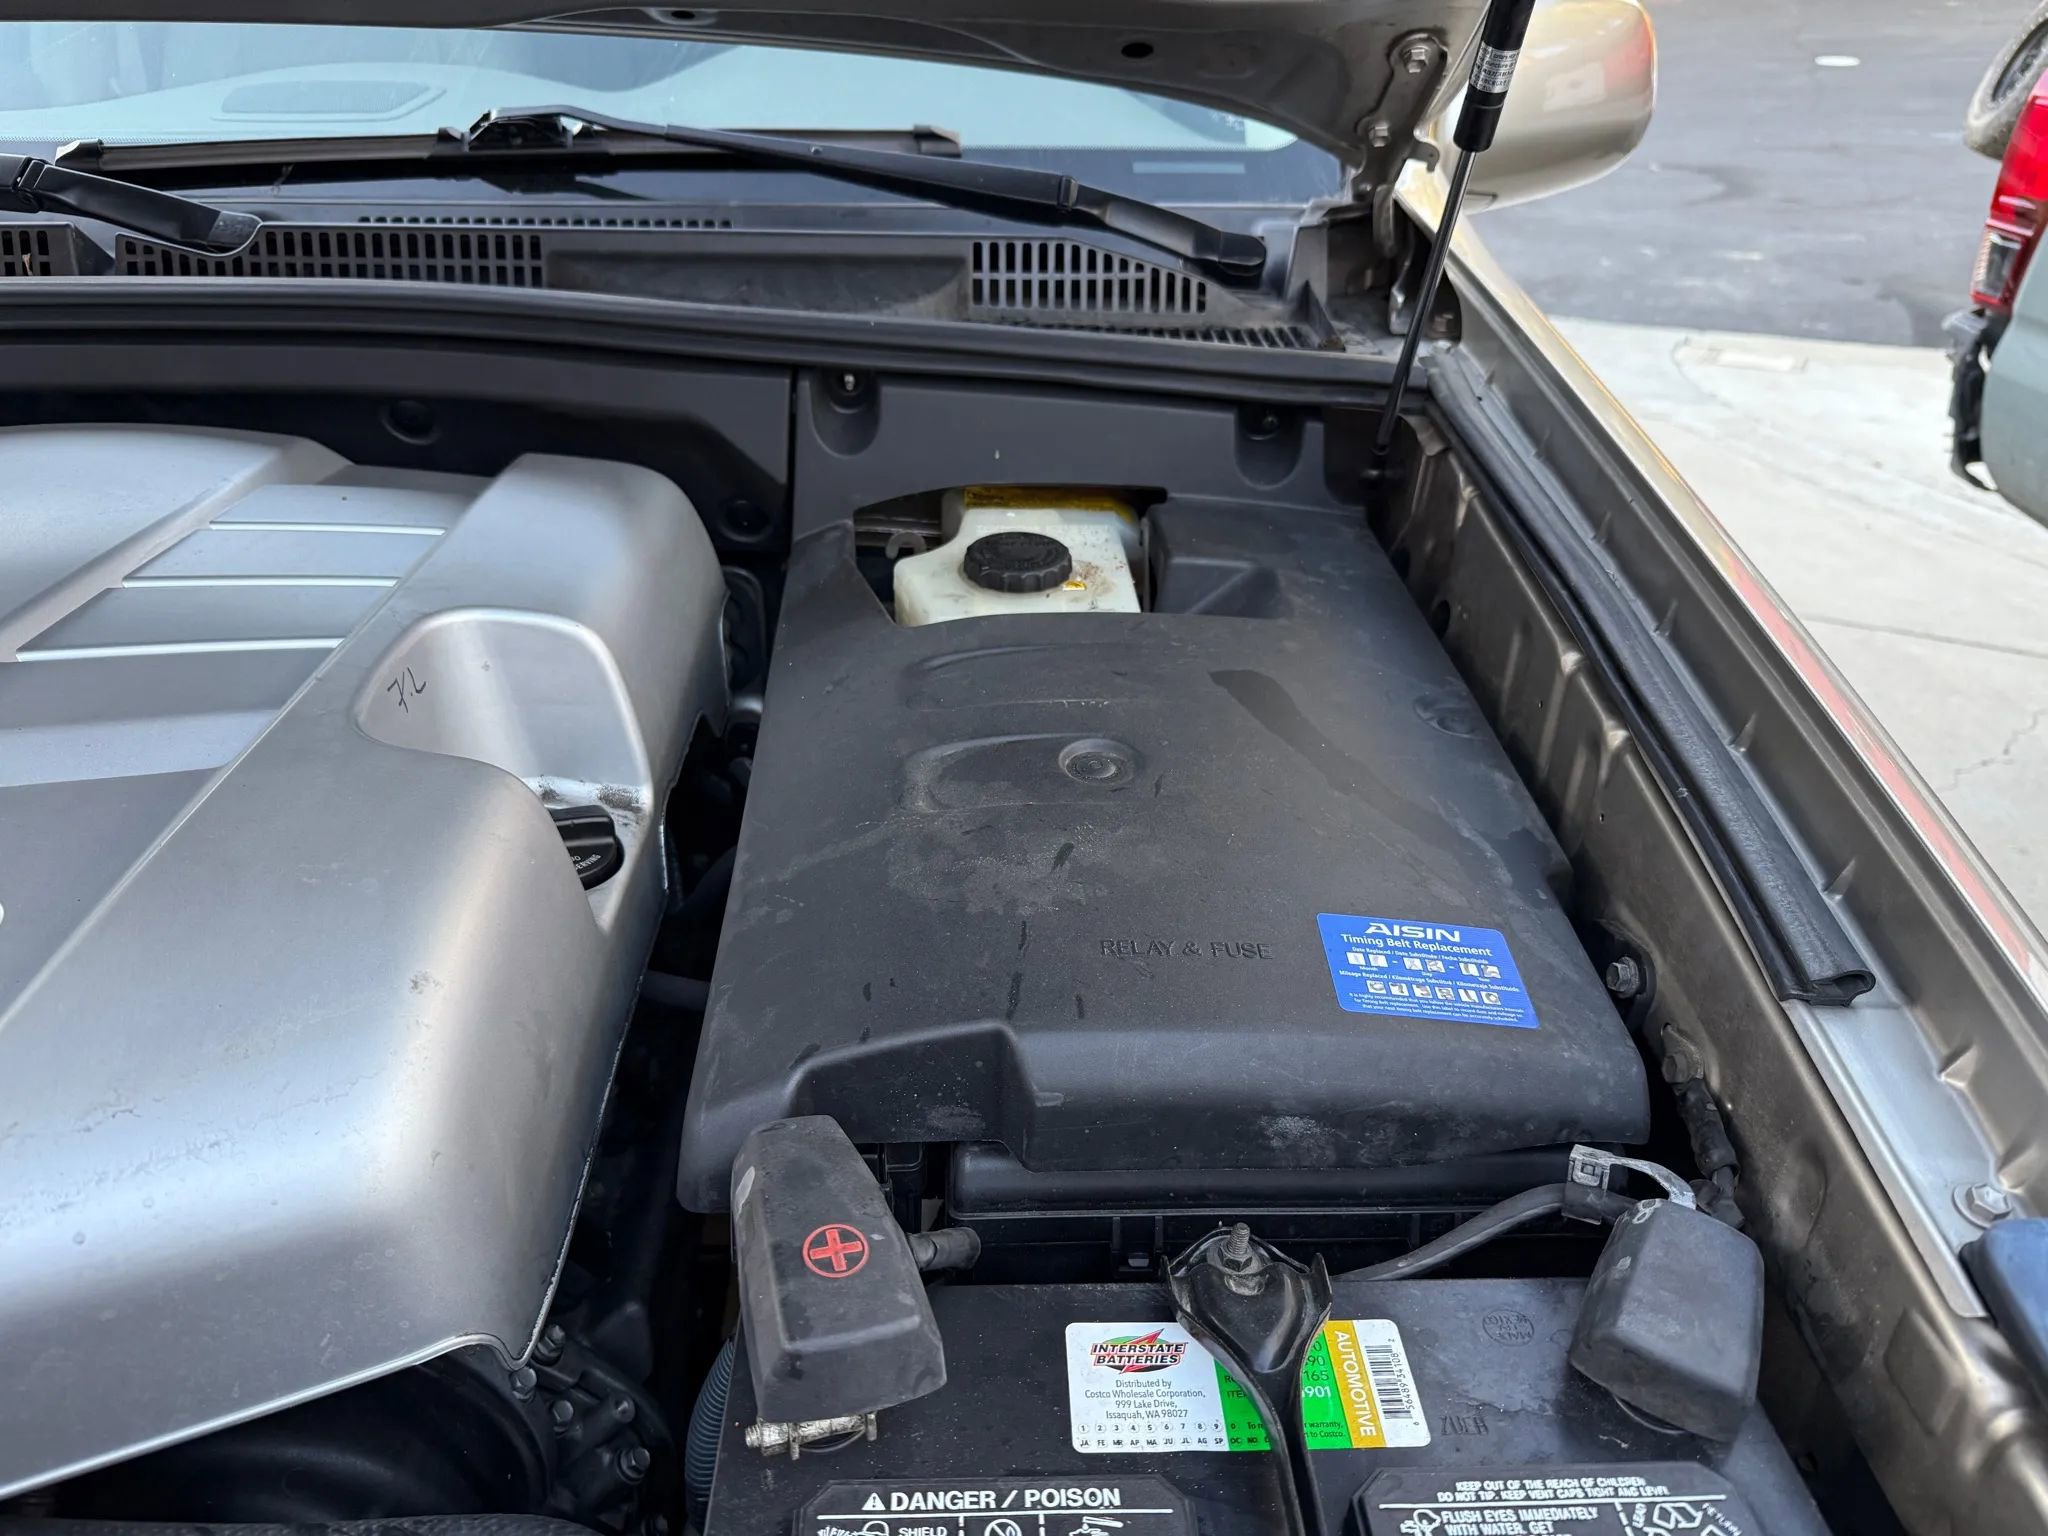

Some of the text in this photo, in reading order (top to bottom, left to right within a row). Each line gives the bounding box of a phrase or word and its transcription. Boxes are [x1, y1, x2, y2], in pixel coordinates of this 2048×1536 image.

[1364, 922, 1461, 943] AISIN
[1101, 938, 1272, 959] RELAY & FUSE
[1341, 933, 1492, 957] Timing Belt Replacement
[1092, 1343, 1184, 1354] INTERSTATE
[1096, 1354, 1178, 1365] BATTERIES
[1305, 1355, 1326, 1366] 90
[1391, 1353, 1405, 1378] 34108
[1115, 1379, 1172, 1390] Distributed by
[1335, 1331, 1376, 1436] AUTOMOTIVE
[1085, 1389, 1206, 1399] Costco Wholesale Corporation,
[1227, 1390, 1247, 1398] ITE
[1399, 1383, 1415, 1410] 56489
[1115, 1400, 1178, 1409] 999 Lake Drive,
[1106, 1409, 1188, 1420] Issaquah, WA 98027
[1456, 1477, 1646, 1491] KEEP OUT OF THE REACH OF CHILDREN
[890, 1488, 1121, 1511] DANGER / POISON
[1437, 1492, 1454, 1502] DO
[1455, 1491, 1476, 1501] NOT
[1500, 1490, 1526, 1500] KEEP
[1528, 1490, 1555, 1500] VENT
[1556, 1488, 1585, 1499] CAPS
[1585, 1487, 1615, 1497] TIGHT
[1618, 1487, 1639, 1497] AND
[1640, 1486, 1670, 1496] LEVEL
[1441, 1507, 1599, 1523] FLUSH EYES IMMEDIATELY
[1632, 1503, 1647, 1528] LEAD
[898, 1526, 947, 1536] SHIELD
[1444, 1524, 1479, 1536] WITH
[1528, 1521, 1554, 1534] GET
